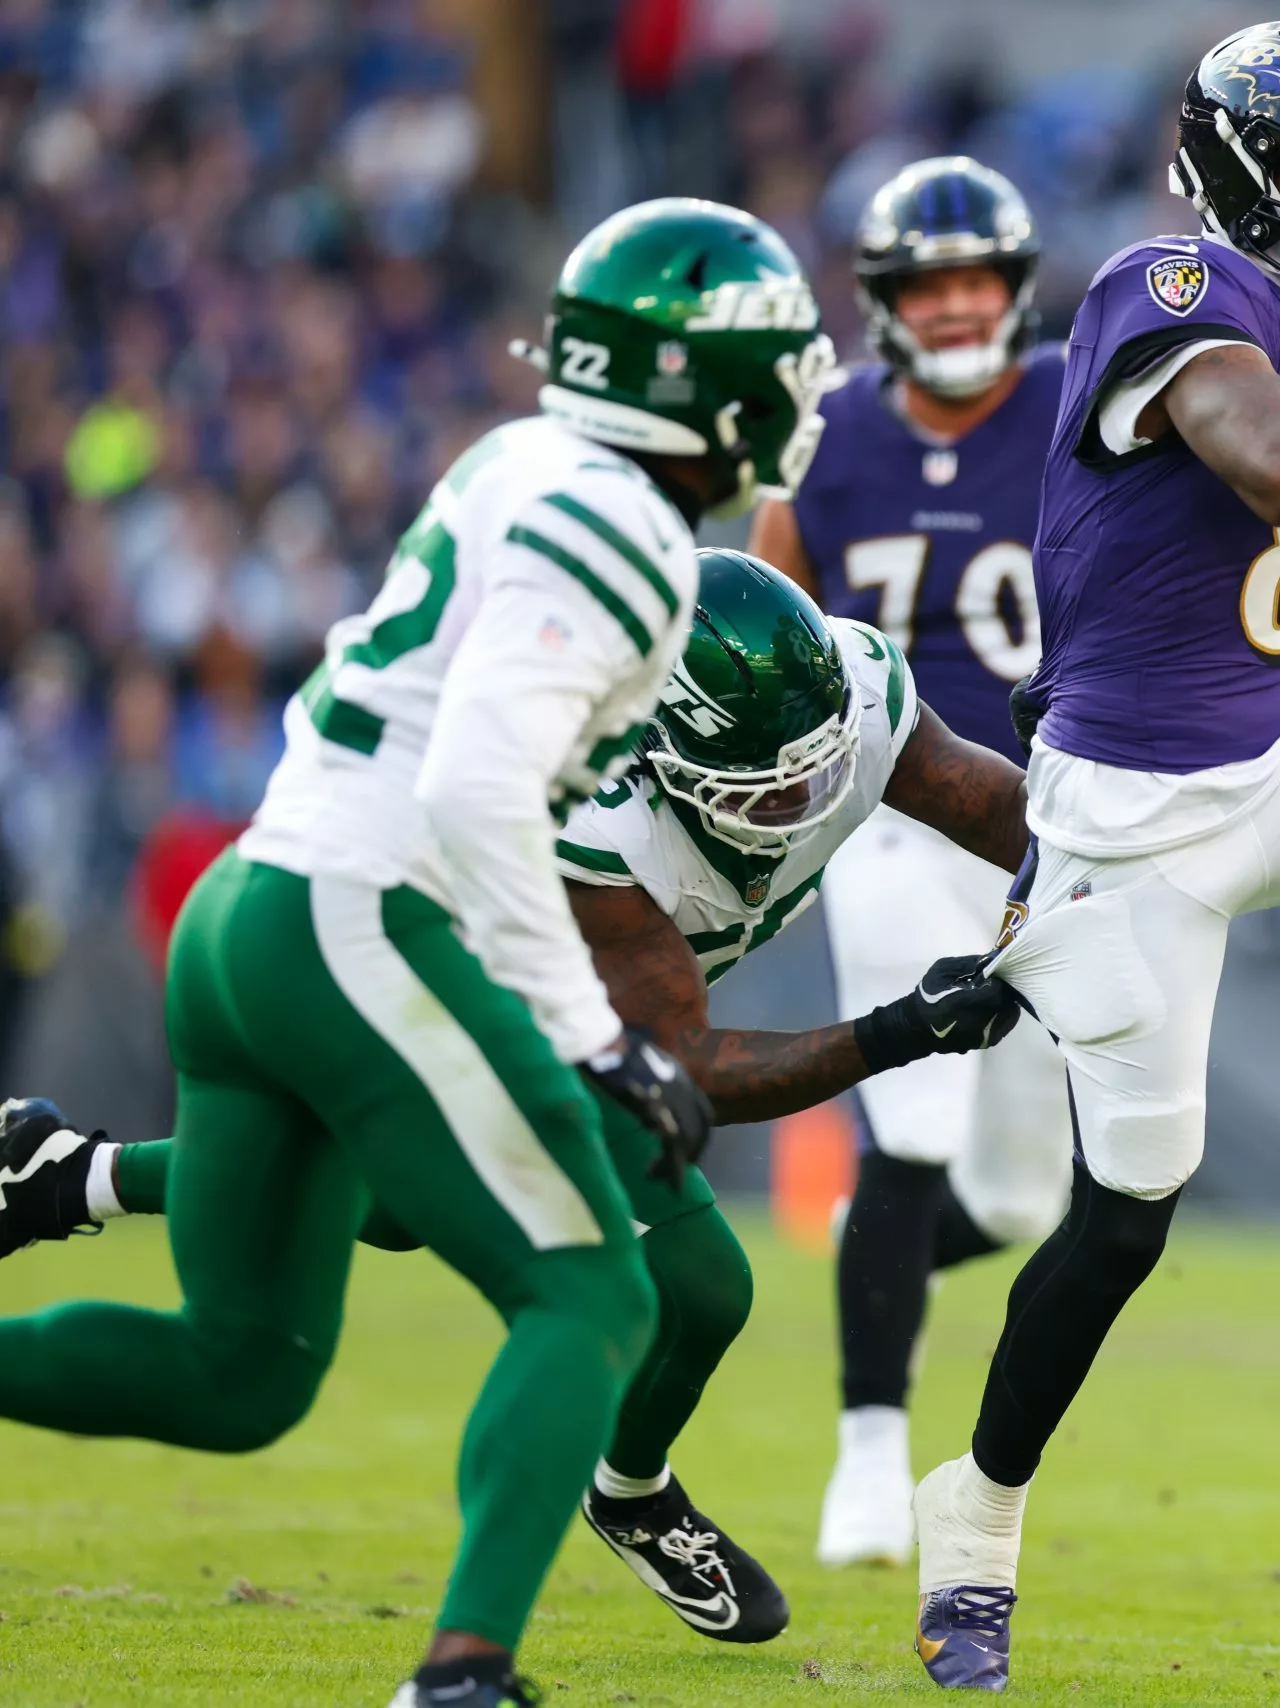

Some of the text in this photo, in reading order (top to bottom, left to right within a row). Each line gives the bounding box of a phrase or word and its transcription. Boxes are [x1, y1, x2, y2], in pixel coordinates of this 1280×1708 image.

[1153, 260, 1199, 275] RAVENS
[683, 273, 819, 332] JETS
[560, 336, 610, 390] 22
[844, 533, 1042, 683] 70
